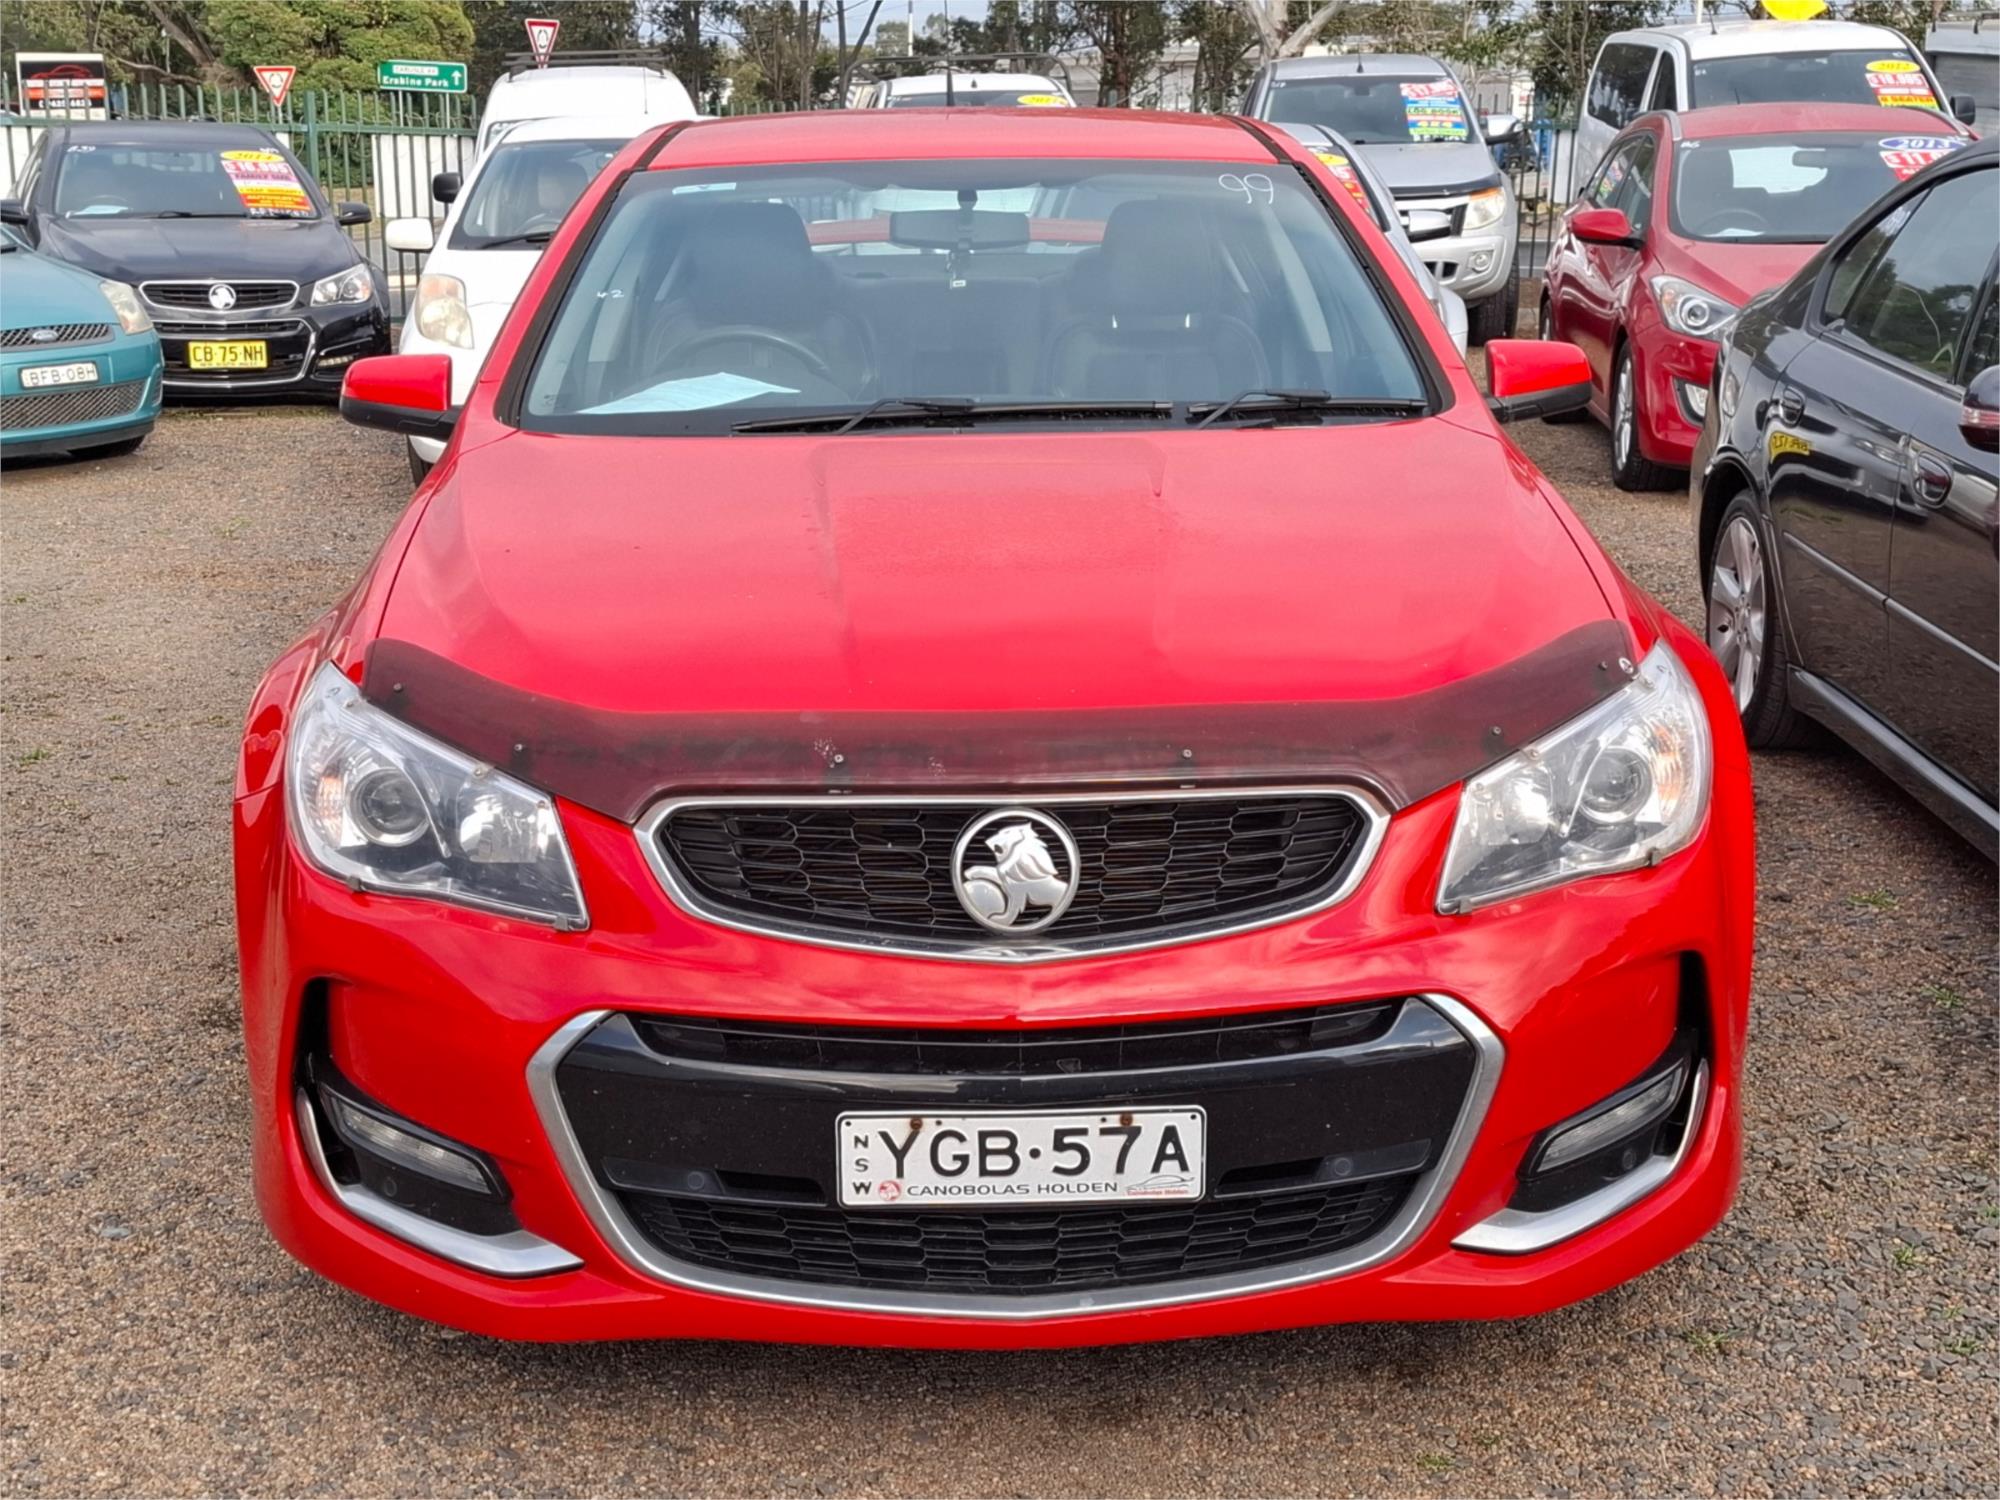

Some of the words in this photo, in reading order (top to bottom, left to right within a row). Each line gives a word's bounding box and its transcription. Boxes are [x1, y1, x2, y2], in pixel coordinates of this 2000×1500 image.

[382, 76, 422, 86] Erskine
[424, 77, 449, 87] Park
[1896, 139, 1949, 149] 2013
[1218, 173, 1274, 204] 99
[906, 1184, 1030, 1197] CANOBOLAS
[1037, 1181, 1118, 1195] HOLDEN
